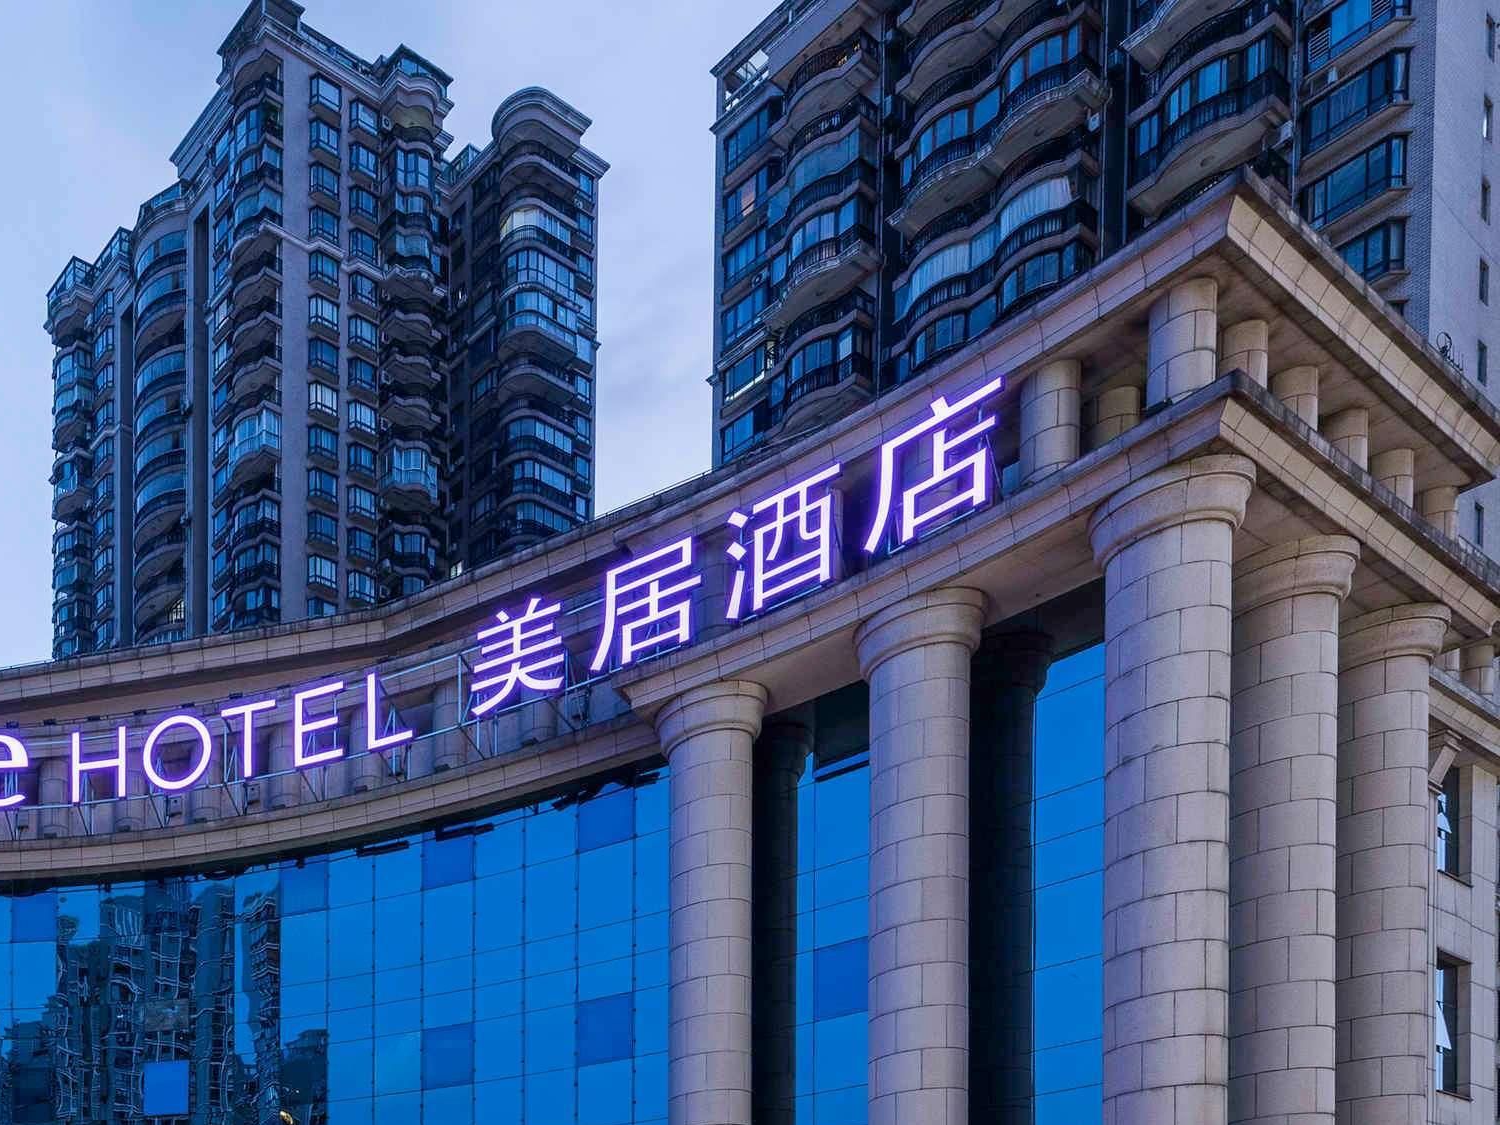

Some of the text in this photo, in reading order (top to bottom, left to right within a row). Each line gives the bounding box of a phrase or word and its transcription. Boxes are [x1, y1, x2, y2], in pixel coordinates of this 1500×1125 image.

[471, 376, 1004, 716] 美居酒店
[71, 673, 413, 803] HOTEL
